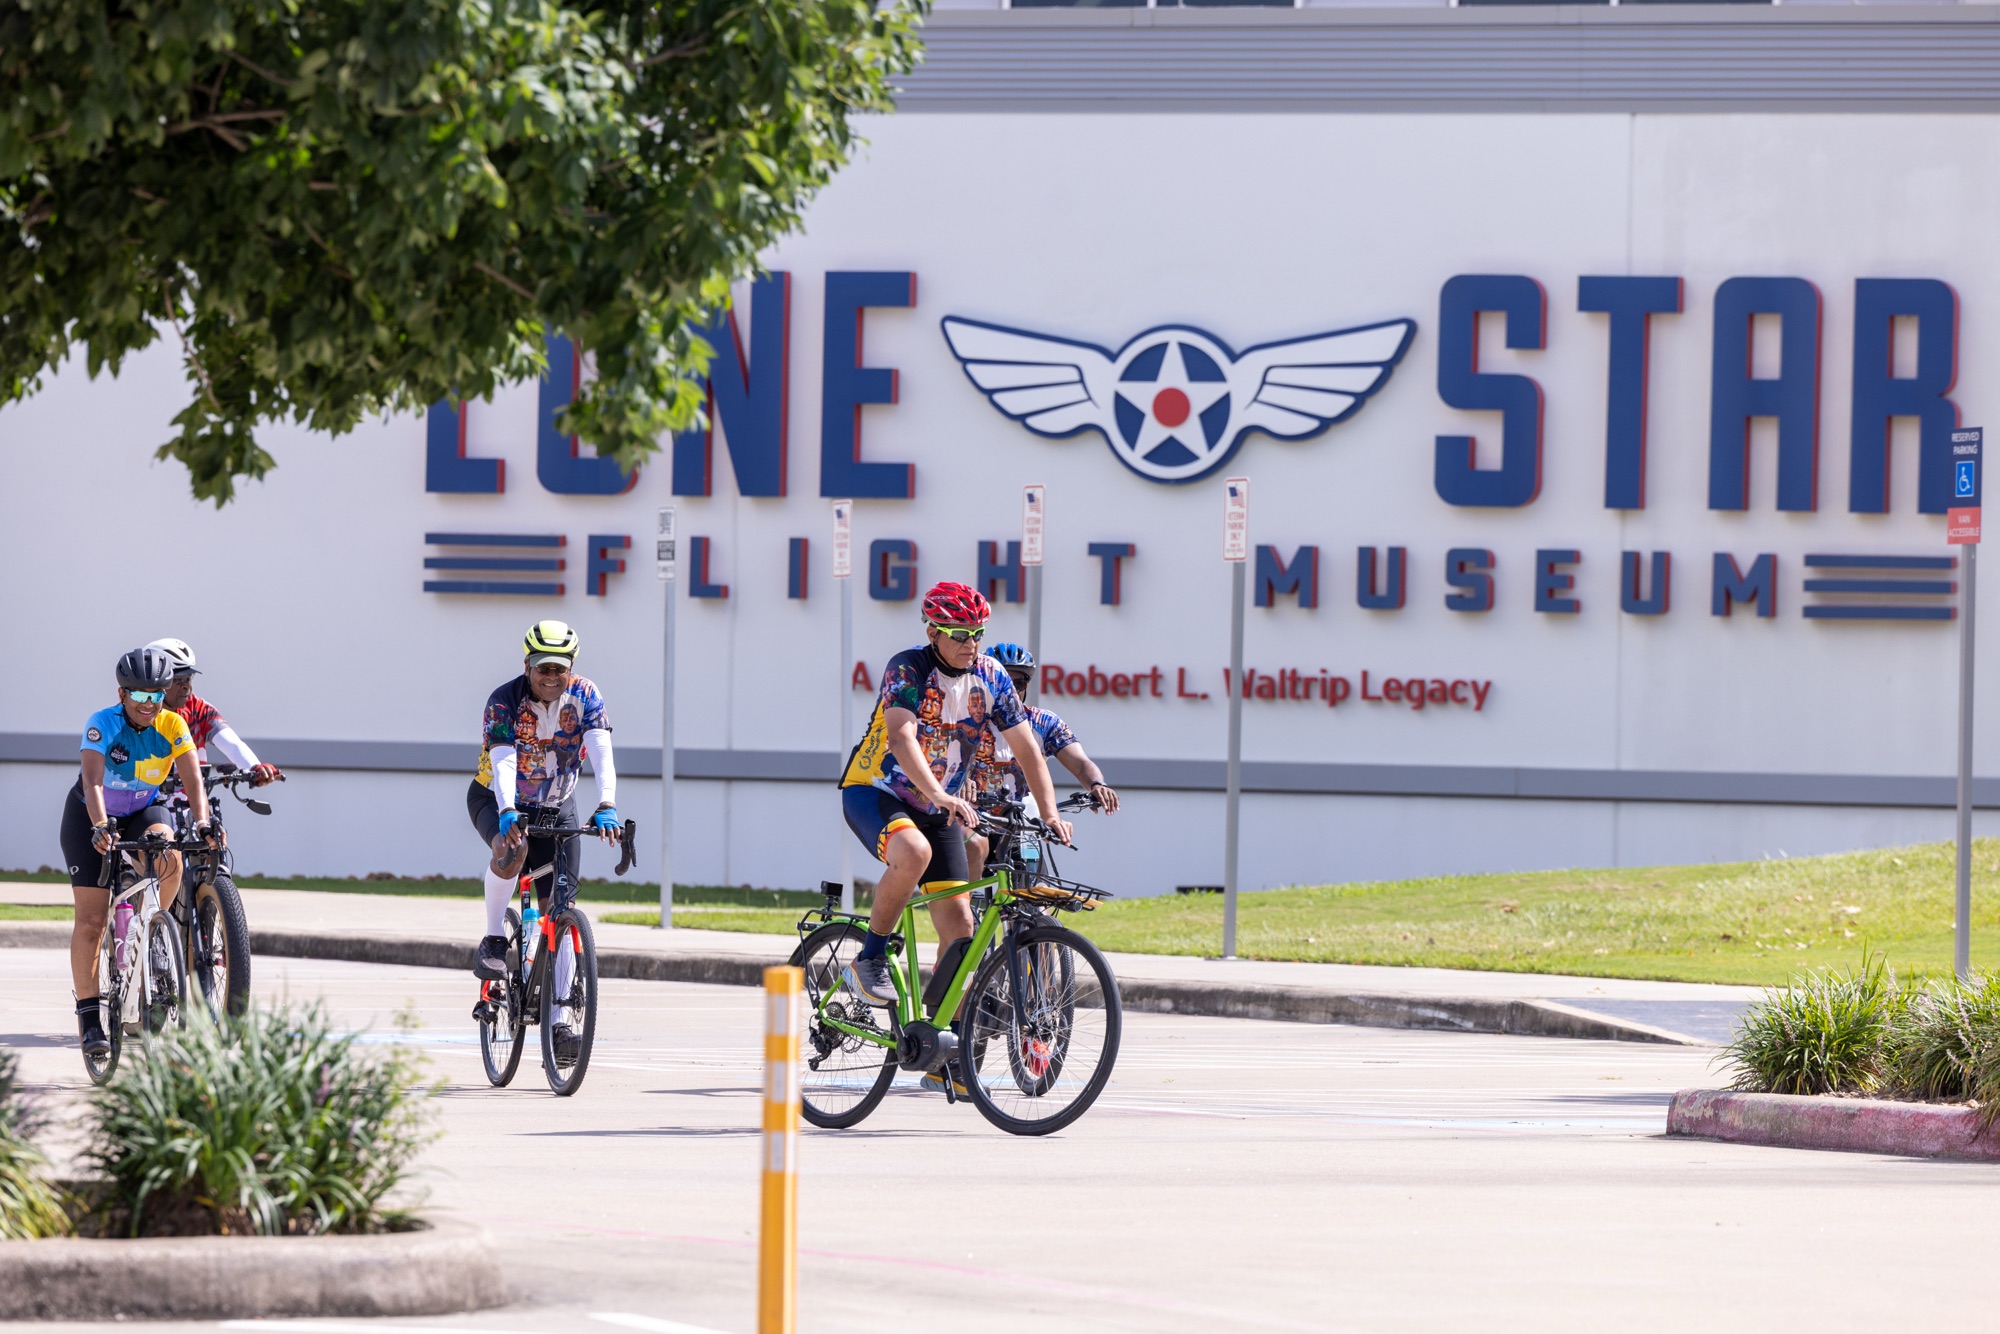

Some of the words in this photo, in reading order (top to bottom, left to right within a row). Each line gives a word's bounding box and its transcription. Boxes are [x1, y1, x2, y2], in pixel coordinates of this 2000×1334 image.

[1434, 274, 1962, 515] STAR
[1951, 431, 1980, 442] RESERVED
[1953, 444, 1979, 455] PARKING
[1957, 515, 1971, 524] VAN
[1948, 527, 1980, 537] ACCESSIBLE
[587, 534, 1135, 605] FLIGHT
[1254, 544, 1777, 618] MUSEUM
[852, 661, 873, 692] A
[1040, 664, 1162, 698] Robert
[1177, 667, 1208, 700] L.
[1361, 670, 1491, 711] Legacy
[110, 751, 128, 761] HOUSTON
